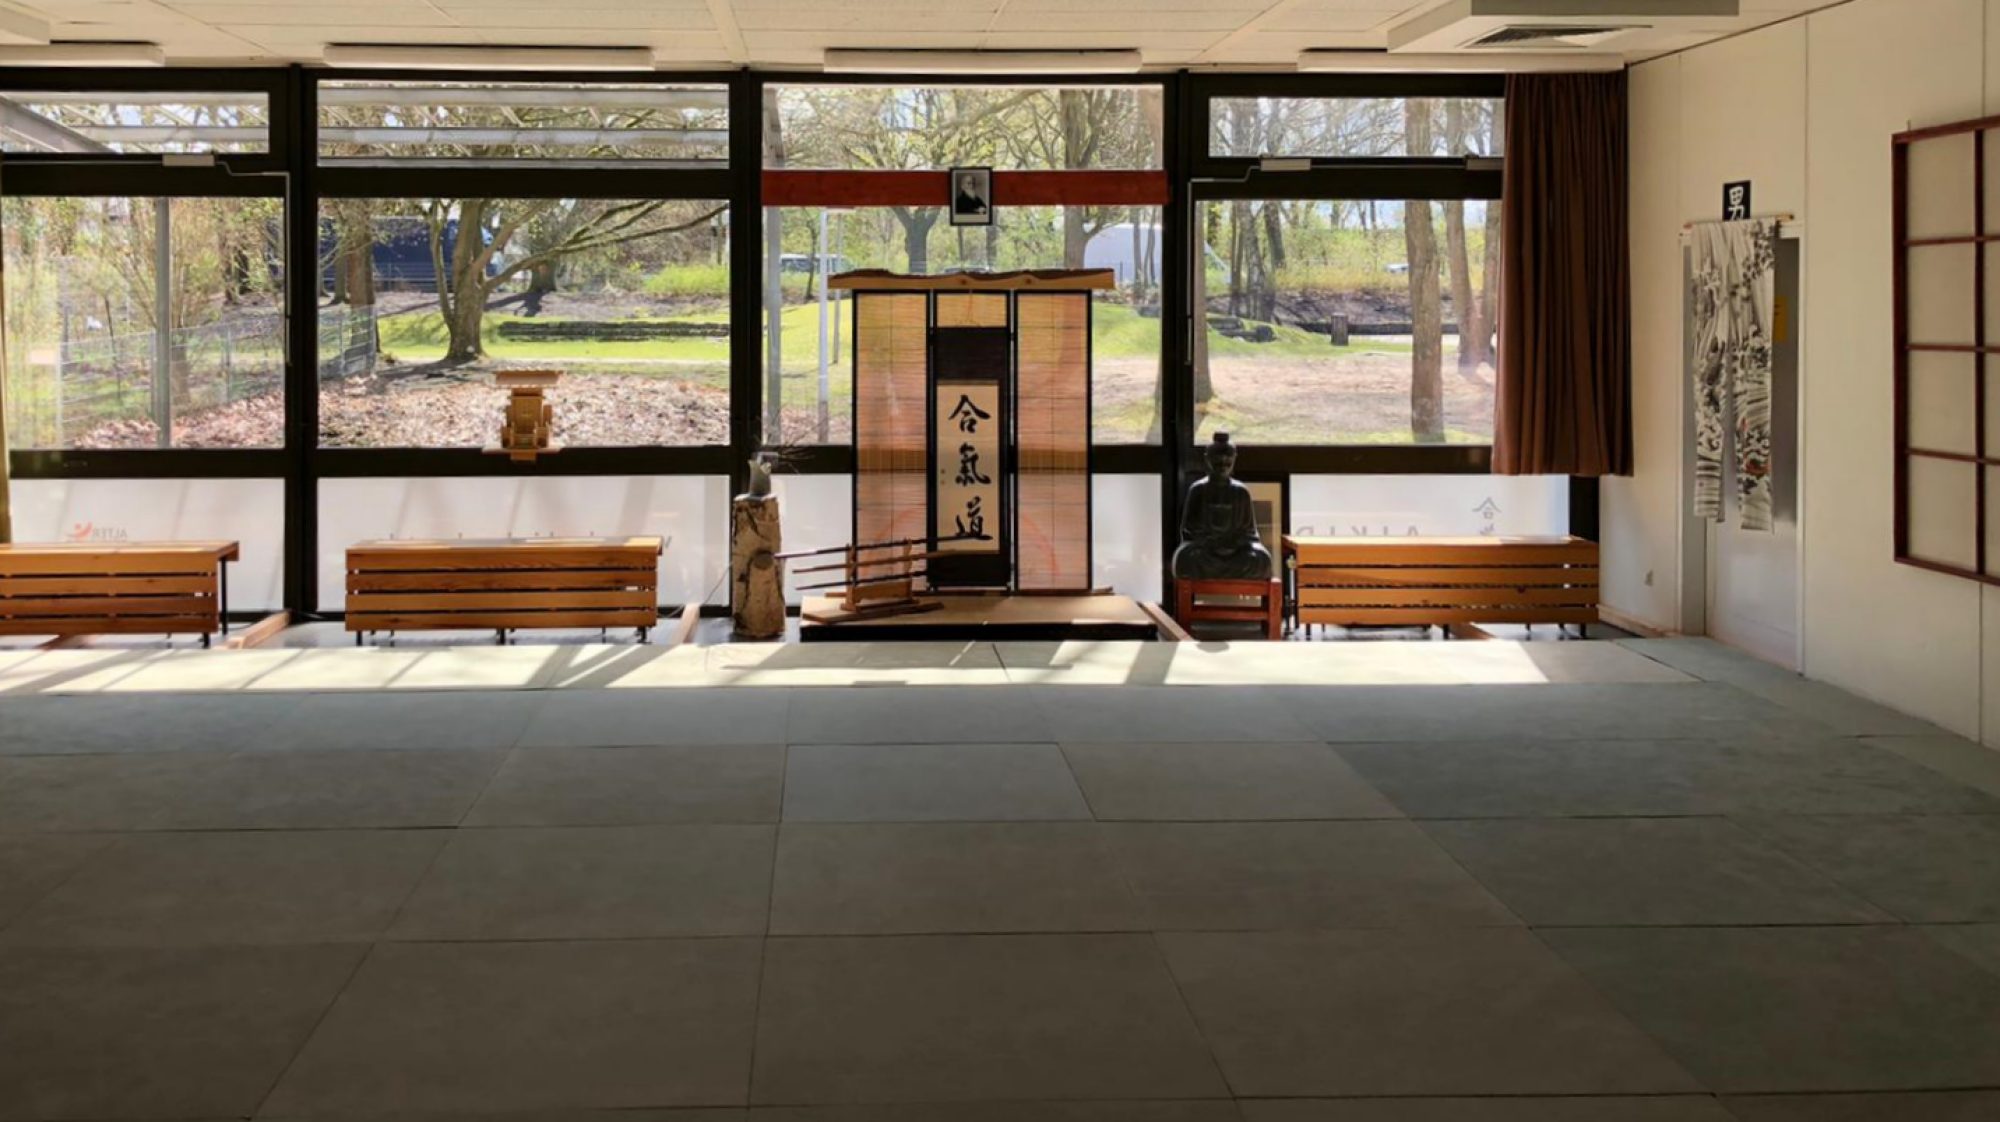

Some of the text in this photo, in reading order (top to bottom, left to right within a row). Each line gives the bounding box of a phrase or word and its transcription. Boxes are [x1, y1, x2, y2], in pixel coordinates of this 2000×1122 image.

[1728, 186, 1745, 222] 男
[949, 394, 993, 540] 合氣道
